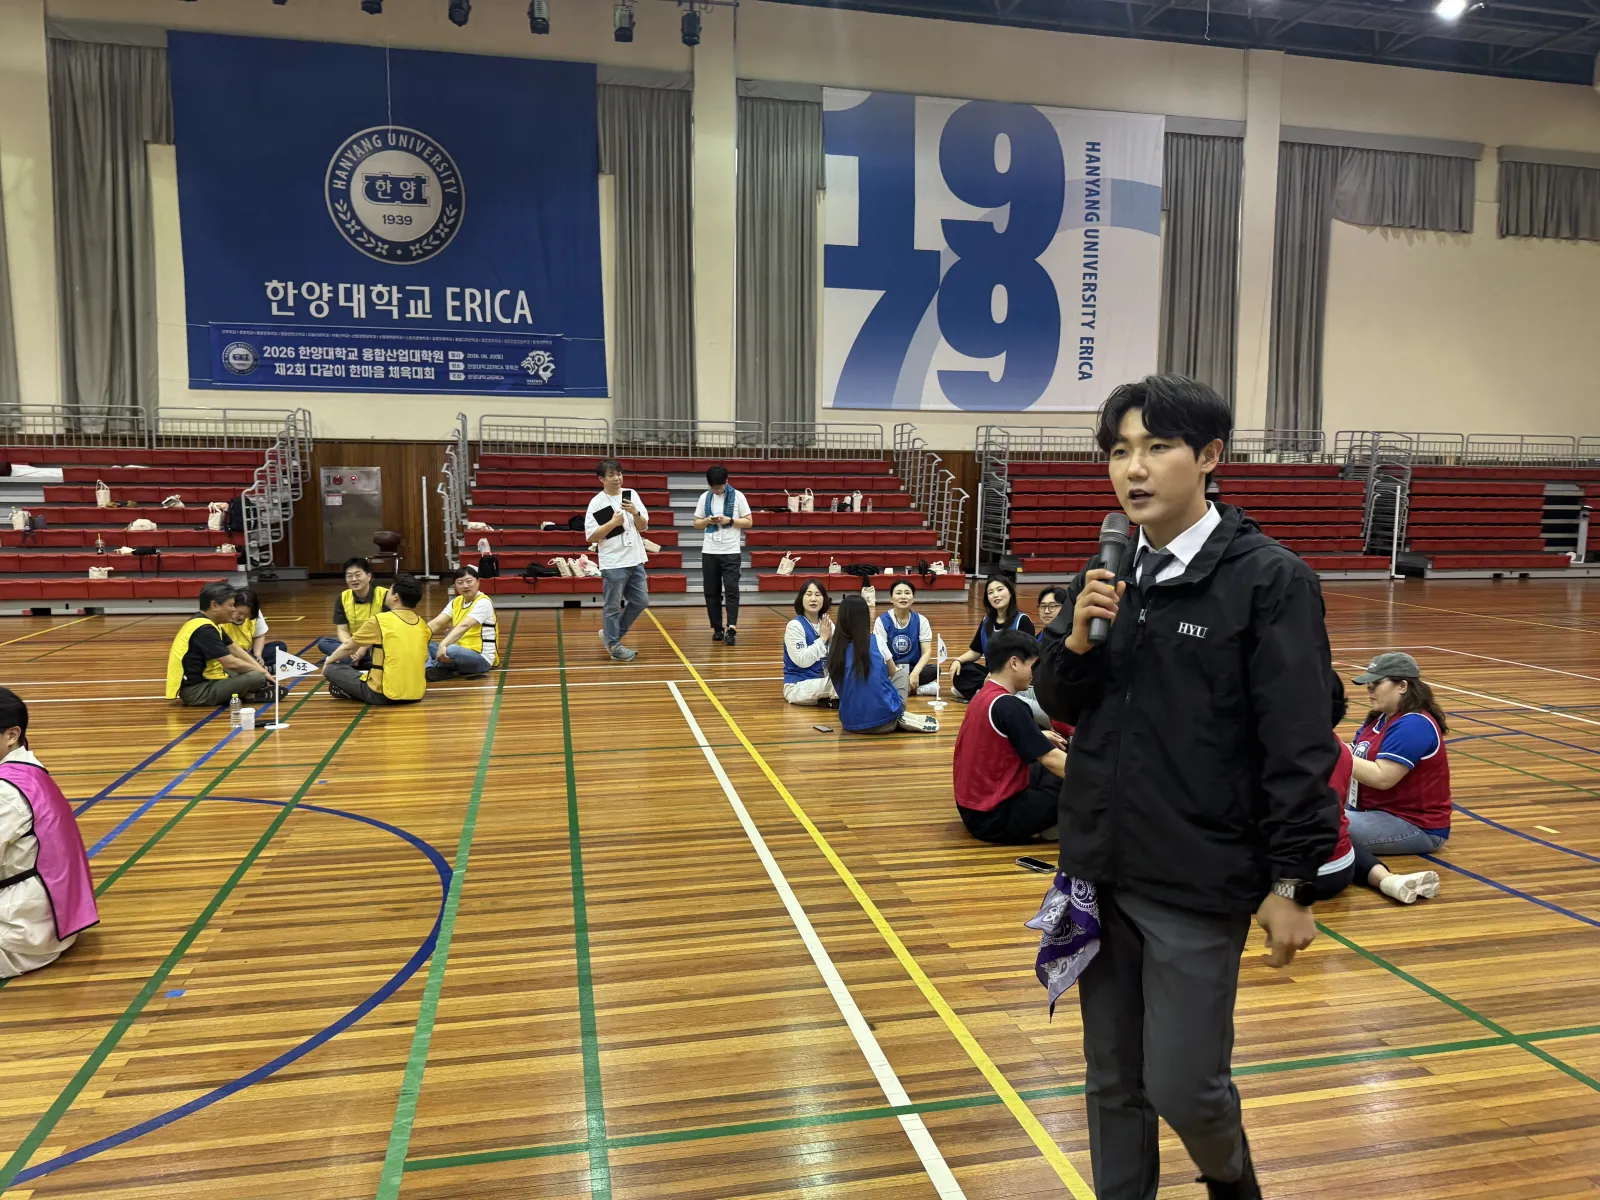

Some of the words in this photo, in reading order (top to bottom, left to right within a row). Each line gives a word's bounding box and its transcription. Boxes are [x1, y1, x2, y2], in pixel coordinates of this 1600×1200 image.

[333, 134, 382, 190] HANYANG
[387, 133, 458, 194] UNIVERSITY
[375, 179, 416, 200] 한양
[1083, 141, 1101, 223] HANYANG
[382, 214, 413, 226] 1939
[1080, 228, 1100, 330] UNIVERSITY
[264, 279, 433, 320] 한양대학교
[446, 287, 533, 325] ERICA
[263, 346, 296, 359] 2026
[298, 346, 359, 361] 한양대학교
[362, 348, 444, 363] 융합산업대학원
[1077, 336, 1095, 381] ERICA
[274, 362, 306, 376] 제2회
[310, 363, 346, 378] 다같이
[349, 364, 385, 379] 한마음
[388, 365, 435, 380] 체육대회
[1176, 621, 1209, 639] HYU
[296, 662, 308, 671] 5조
